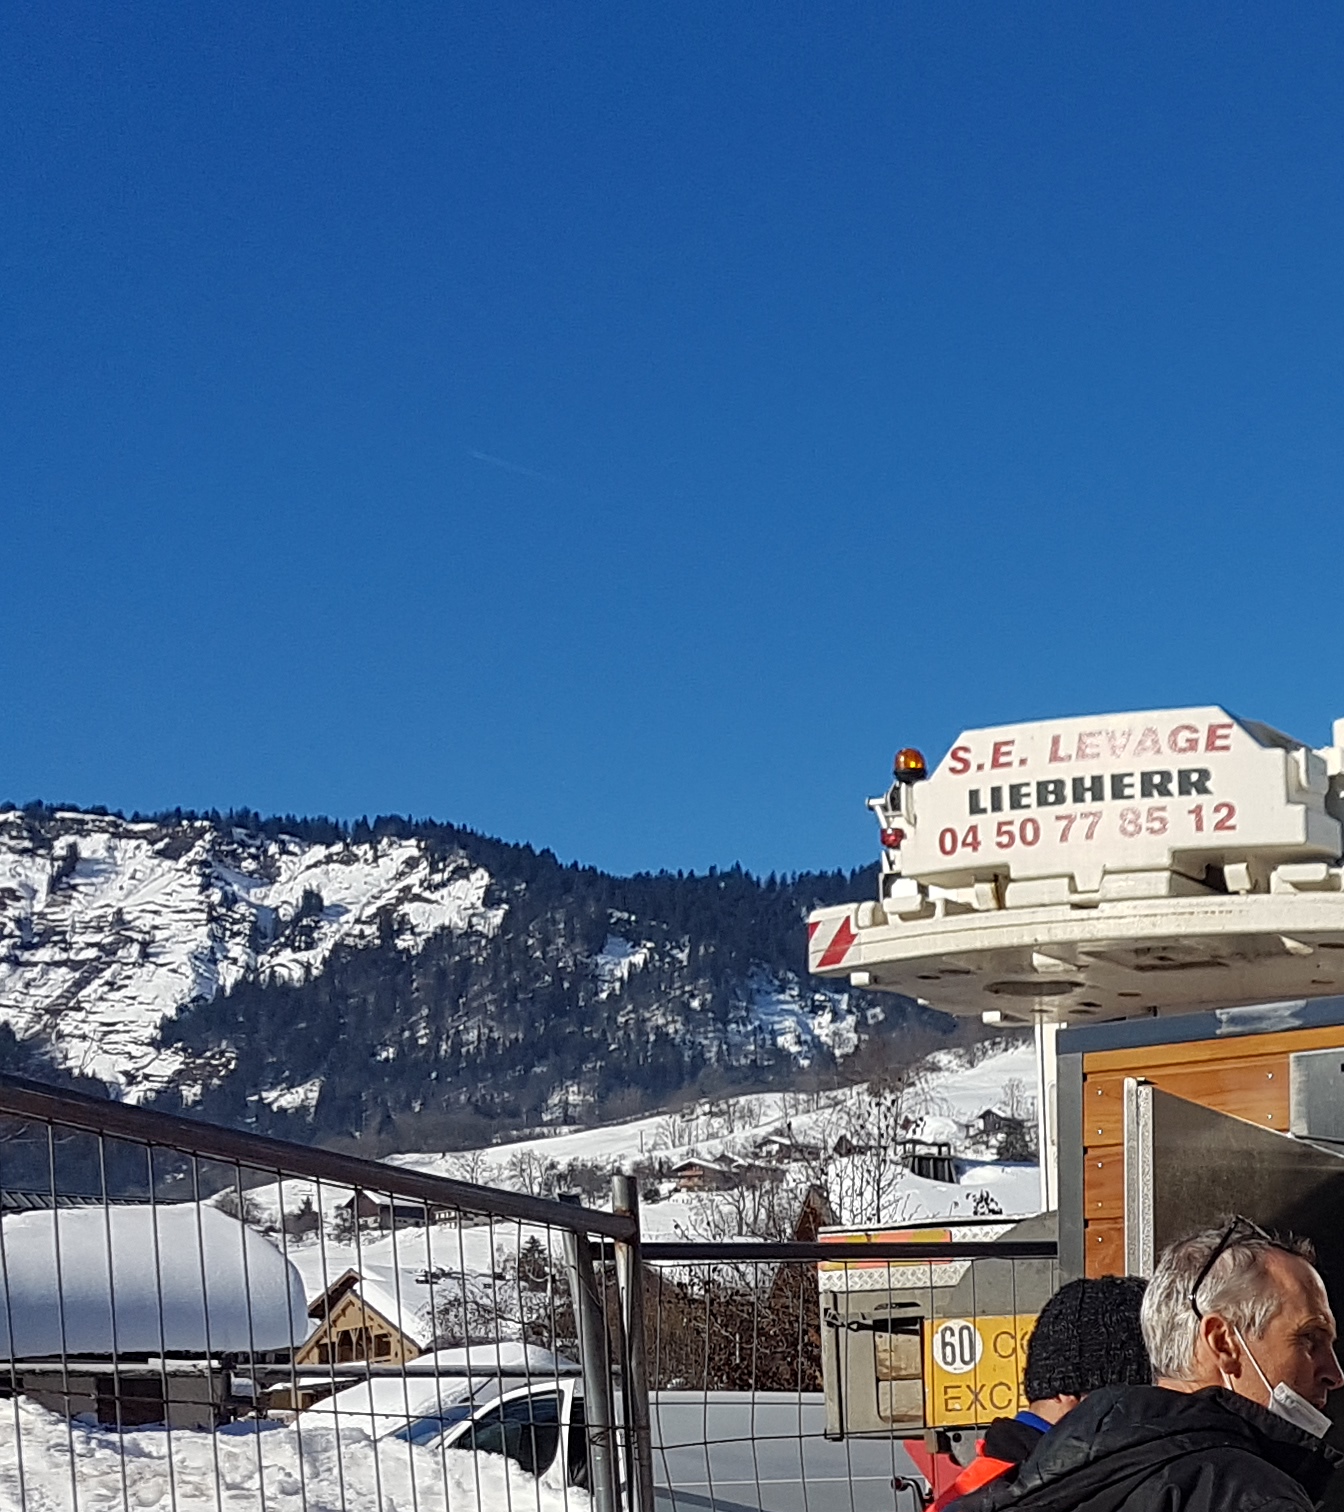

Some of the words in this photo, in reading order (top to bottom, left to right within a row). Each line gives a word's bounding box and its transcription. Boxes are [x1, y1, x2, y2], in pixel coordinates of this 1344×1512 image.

[948, 739, 1029, 775] S.E.
[1047, 722, 1236, 765] LEVAGE
[967, 766, 1214, 816] LIEBHERR
[937, 823, 982, 856] 04
[994, 817, 1042, 849] 50
[1054, 810, 1104, 843] 77
[1187, 802, 1238, 833] 12
[940, 1324, 976, 1367] 60
